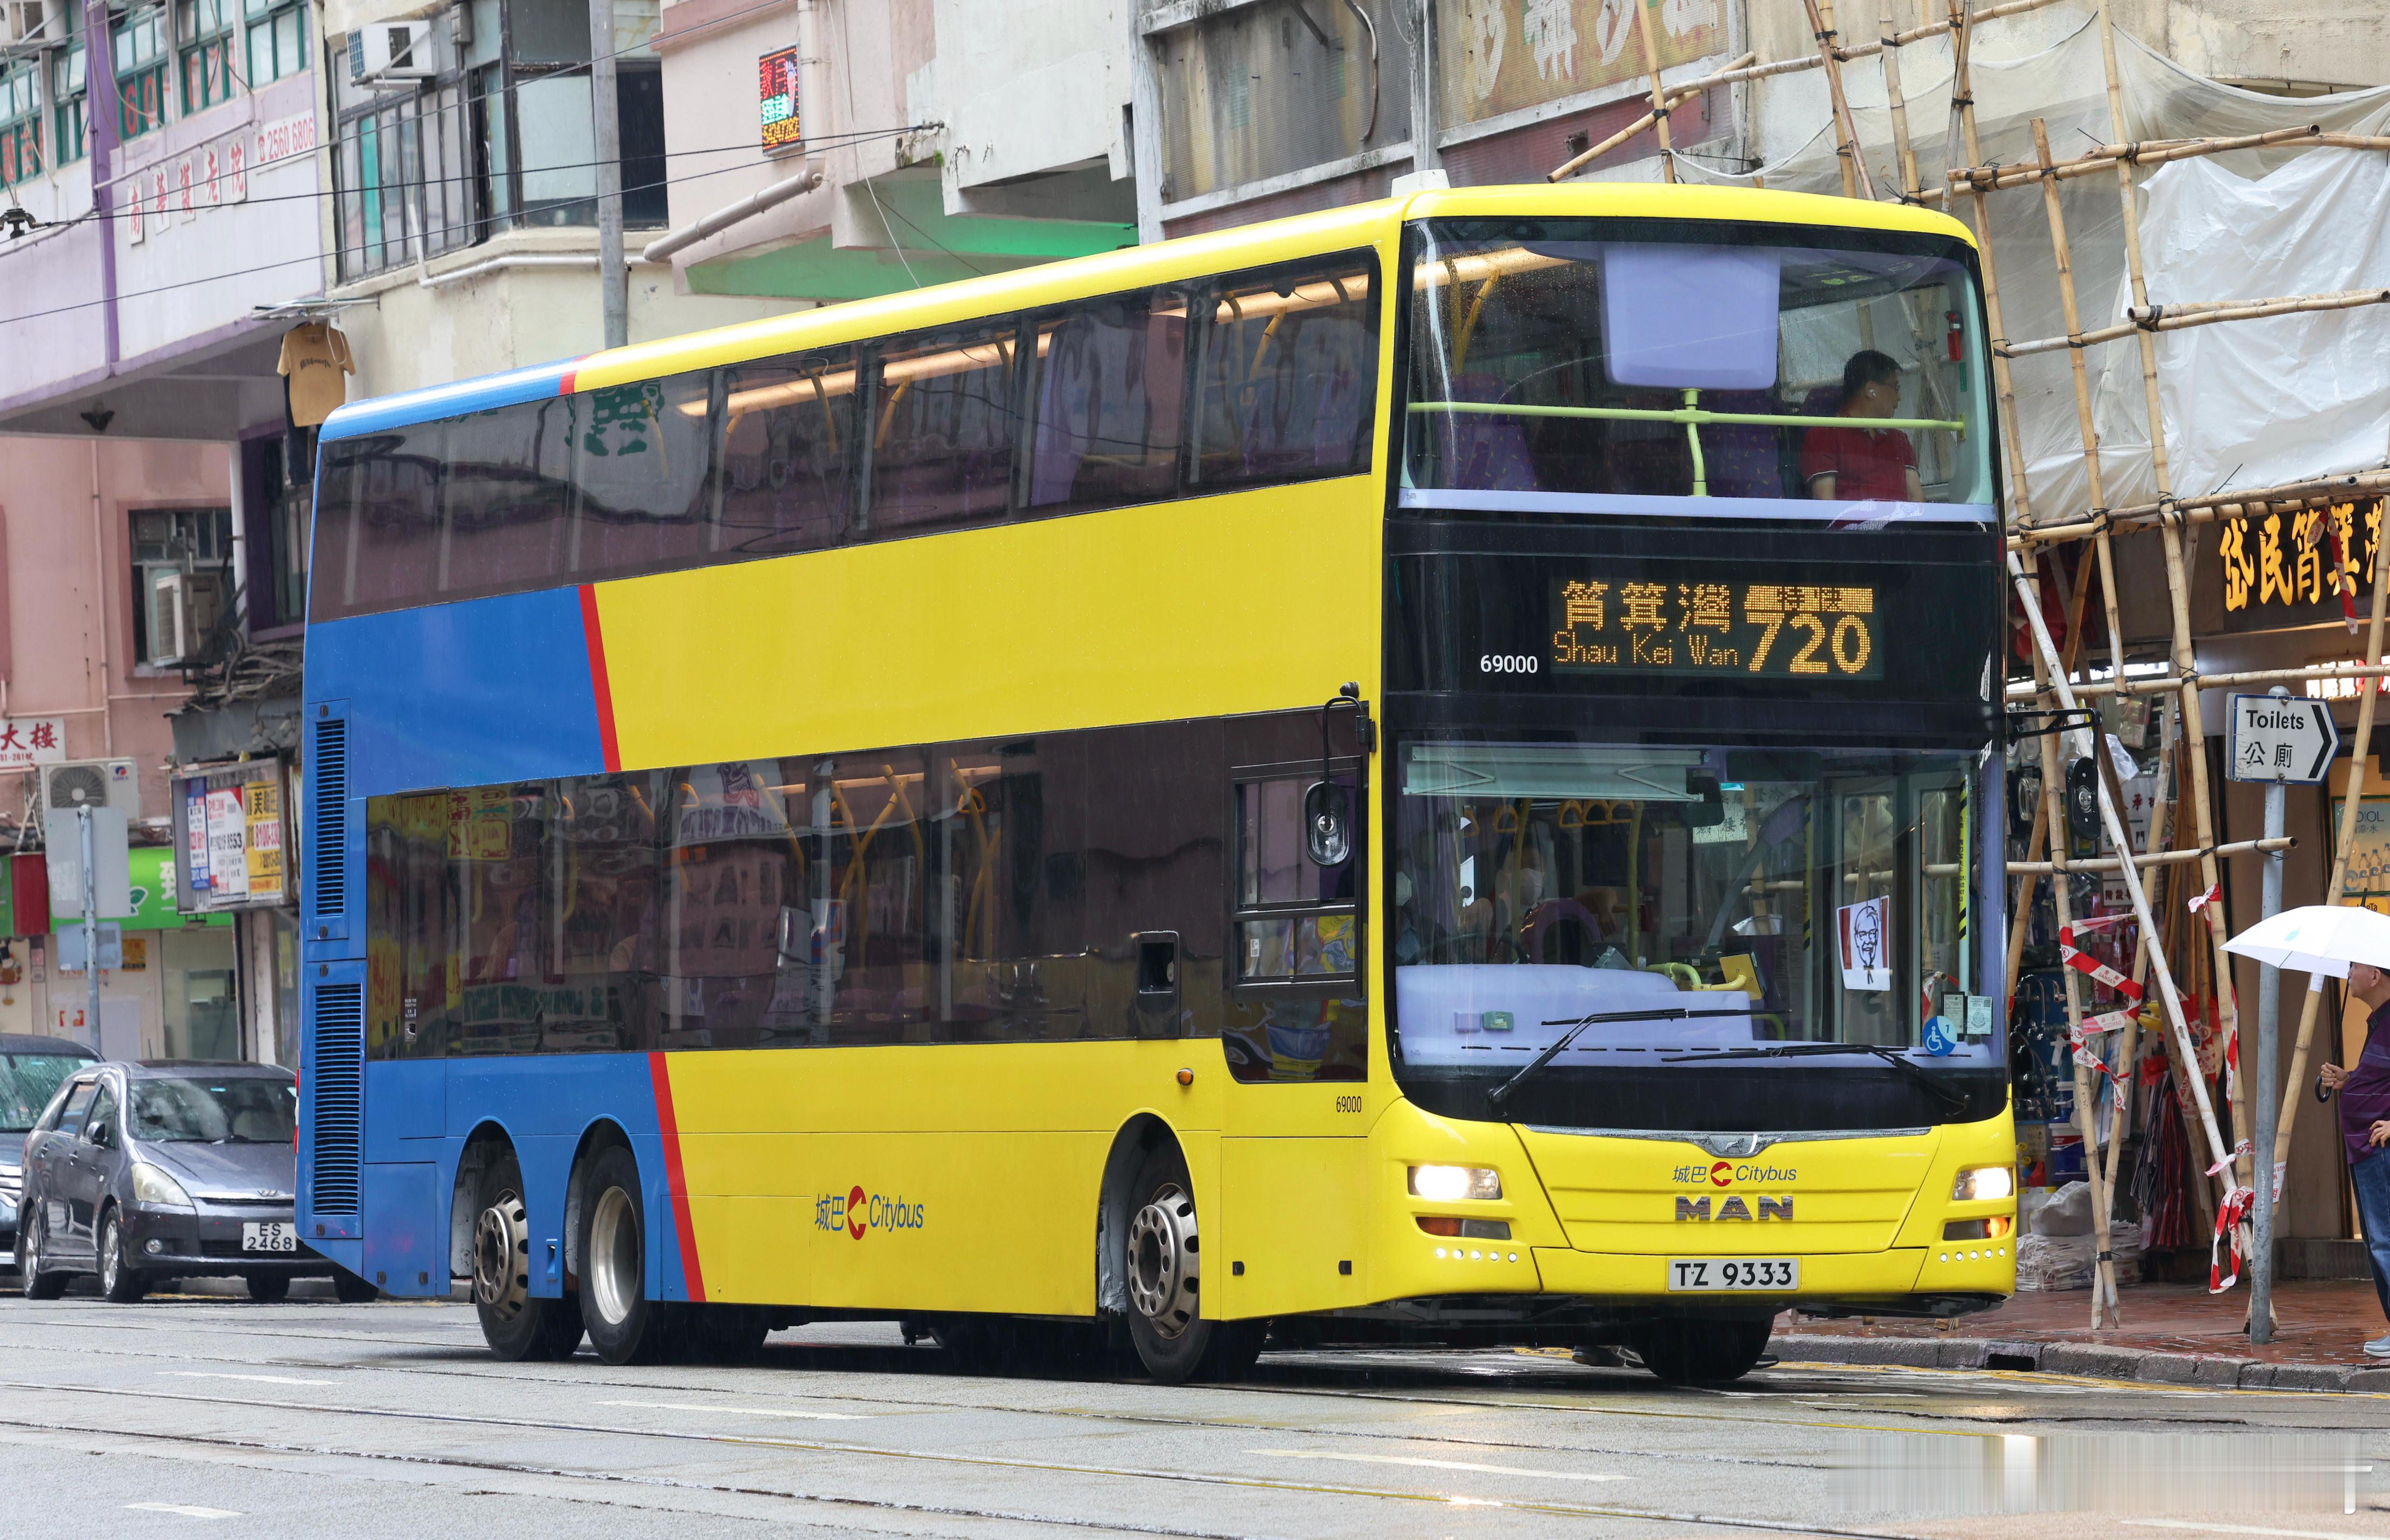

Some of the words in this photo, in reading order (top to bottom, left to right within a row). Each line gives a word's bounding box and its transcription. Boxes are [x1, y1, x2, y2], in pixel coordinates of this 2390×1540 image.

[268, 125, 290, 160] 2560
[292, 116, 314, 152] 6806
[1561, 580, 1730, 633] 筲箕灣
[1553, 630, 1617, 663] Shau
[1632, 632, 1673, 664] Kei
[1688, 634, 1738, 666] Wan
[1746, 611, 1872, 674] 720
[1480, 654, 1538, 674] 69000
[2246, 709, 2305, 730] Toilets
[2244, 741, 2293, 768] 公廁
[2098, 972, 2116, 985] DANGER
[1945, 1024, 1950, 1034] 1
[2077, 1055, 2095, 1065] DANGER
[1336, 1095, 1362, 1113] 69000
[1672, 1165, 1707, 1183] 城巴
[1735, 1164, 1797, 1183] Citybus
[814, 1193, 845, 1231] 城巴
[869, 1193, 924, 1233] Citybus
[1675, 1195, 1794, 1221] MAN
[259, 1223, 281, 1236] ES
[247, 1236, 292, 1250] 2468
[1675, 1263, 1709, 1286] TZ
[1722, 1263, 1792, 1286] 9333
